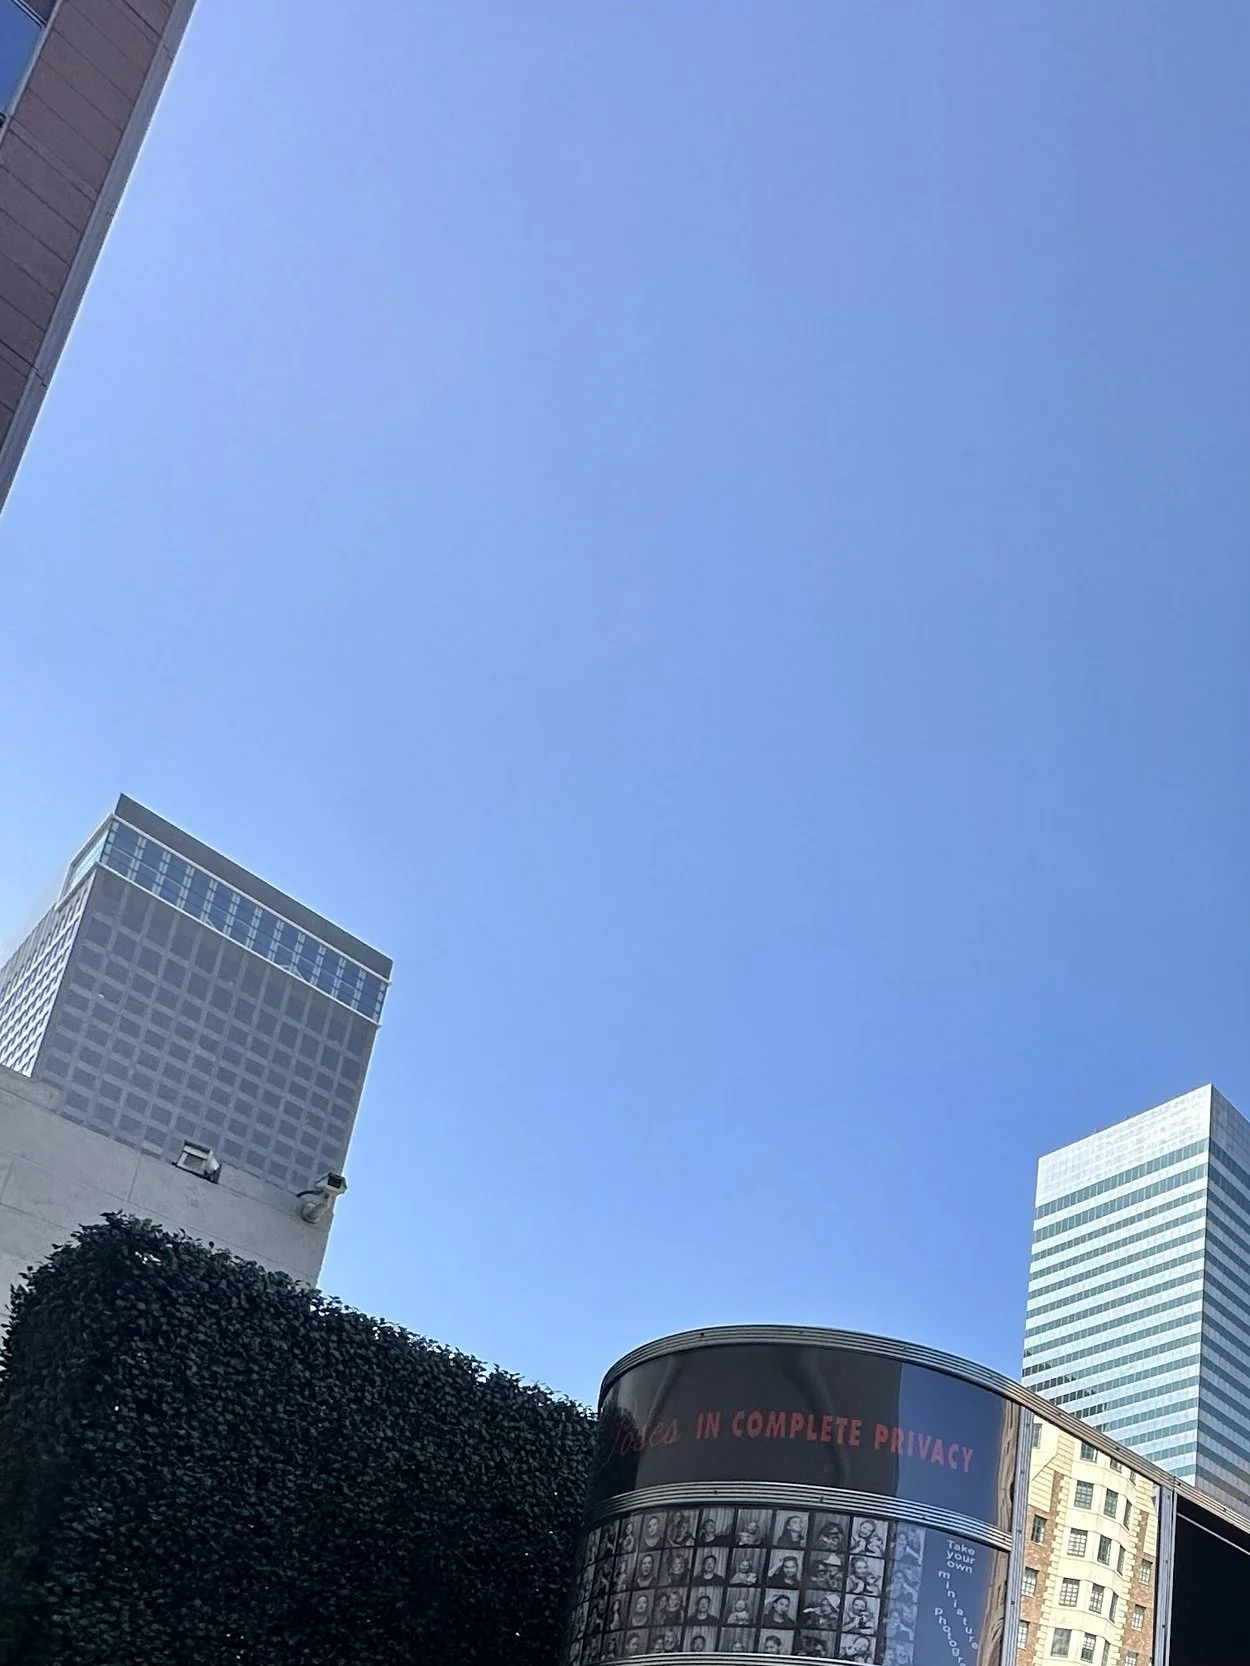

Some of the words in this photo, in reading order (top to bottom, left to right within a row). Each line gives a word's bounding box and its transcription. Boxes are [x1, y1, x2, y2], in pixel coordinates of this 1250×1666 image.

[695, 1411, 722, 1440] IN
[732, 1410, 863, 1447] COMPLETE
[874, 1422, 974, 1474] PRIVACY
[947, 1539, 976, 1556] Take
[945, 1549, 976, 1565] your
[946, 1560, 973, 1574] own
[938, 1569, 979, 1650] miniature
